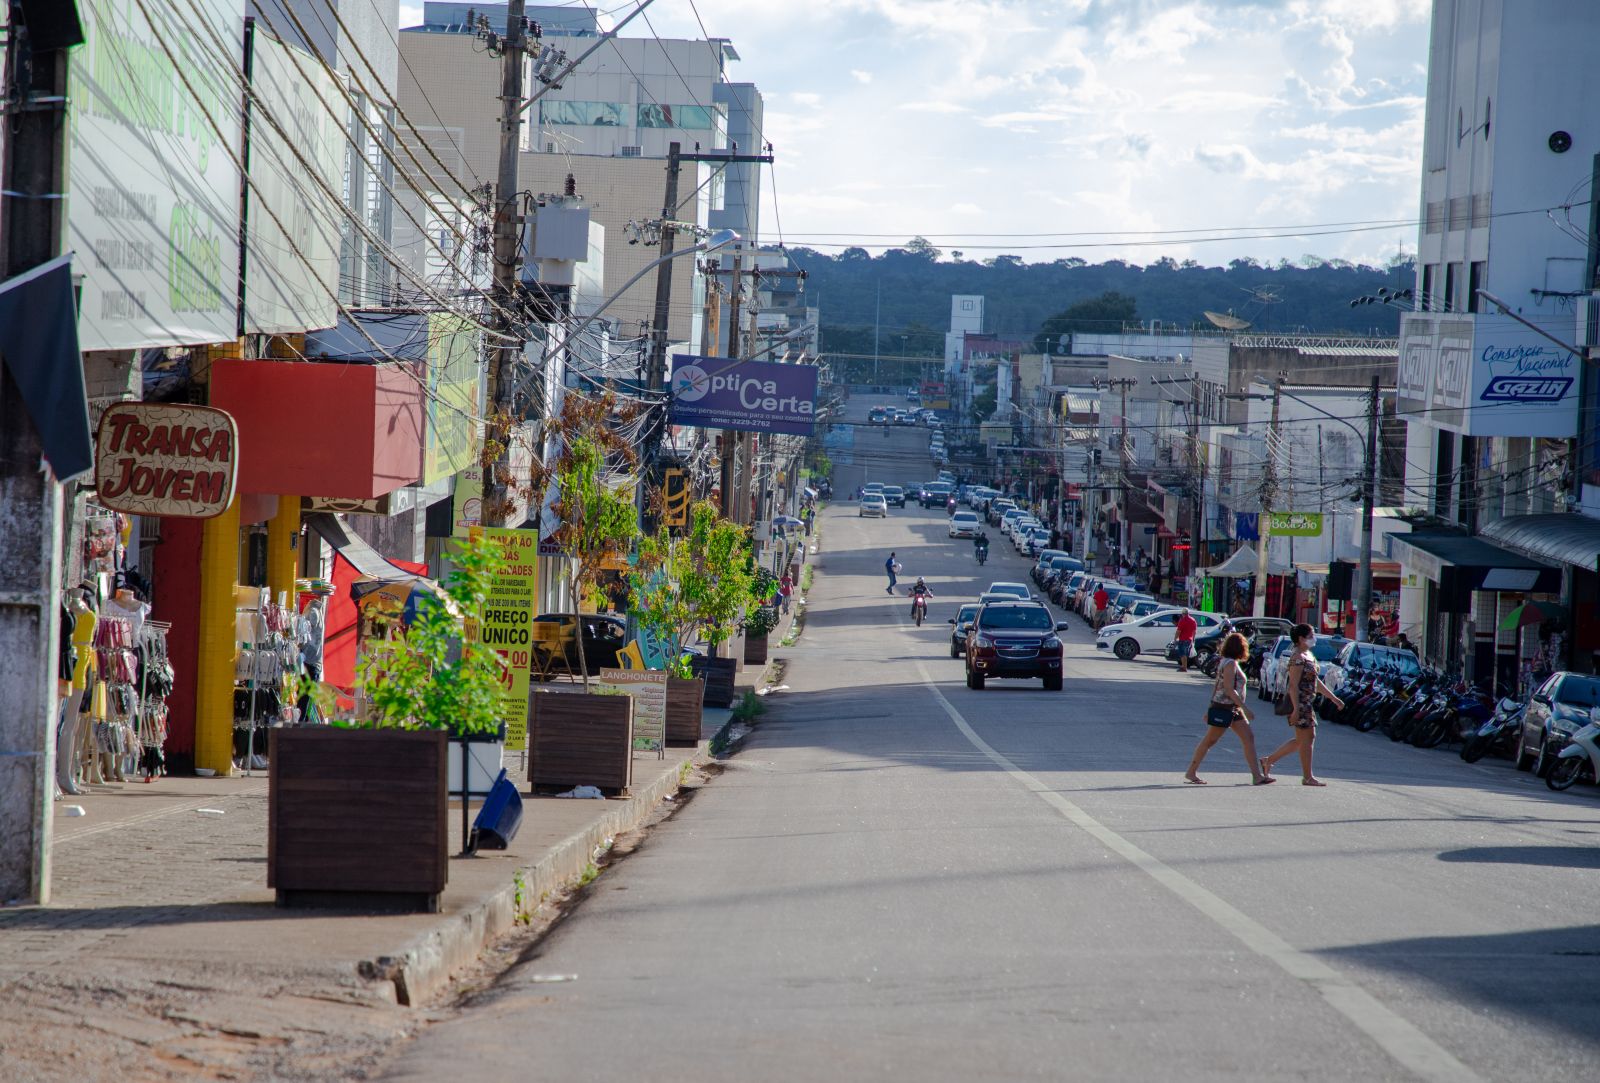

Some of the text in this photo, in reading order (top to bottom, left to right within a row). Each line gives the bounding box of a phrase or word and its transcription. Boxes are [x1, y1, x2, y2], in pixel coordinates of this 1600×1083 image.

[1482, 345, 1544, 362] Consórcio
[1510, 352, 1574, 374] Nacional
[1488, 380, 1568, 398] GAZIN
[109, 414, 230, 462] TRANSA
[102, 458, 225, 504] JOVEM
[485, 610, 529, 627] PREÇO
[482, 624, 529, 645] ÚNICO
[601, 671, 665, 682] LANCHONETE
